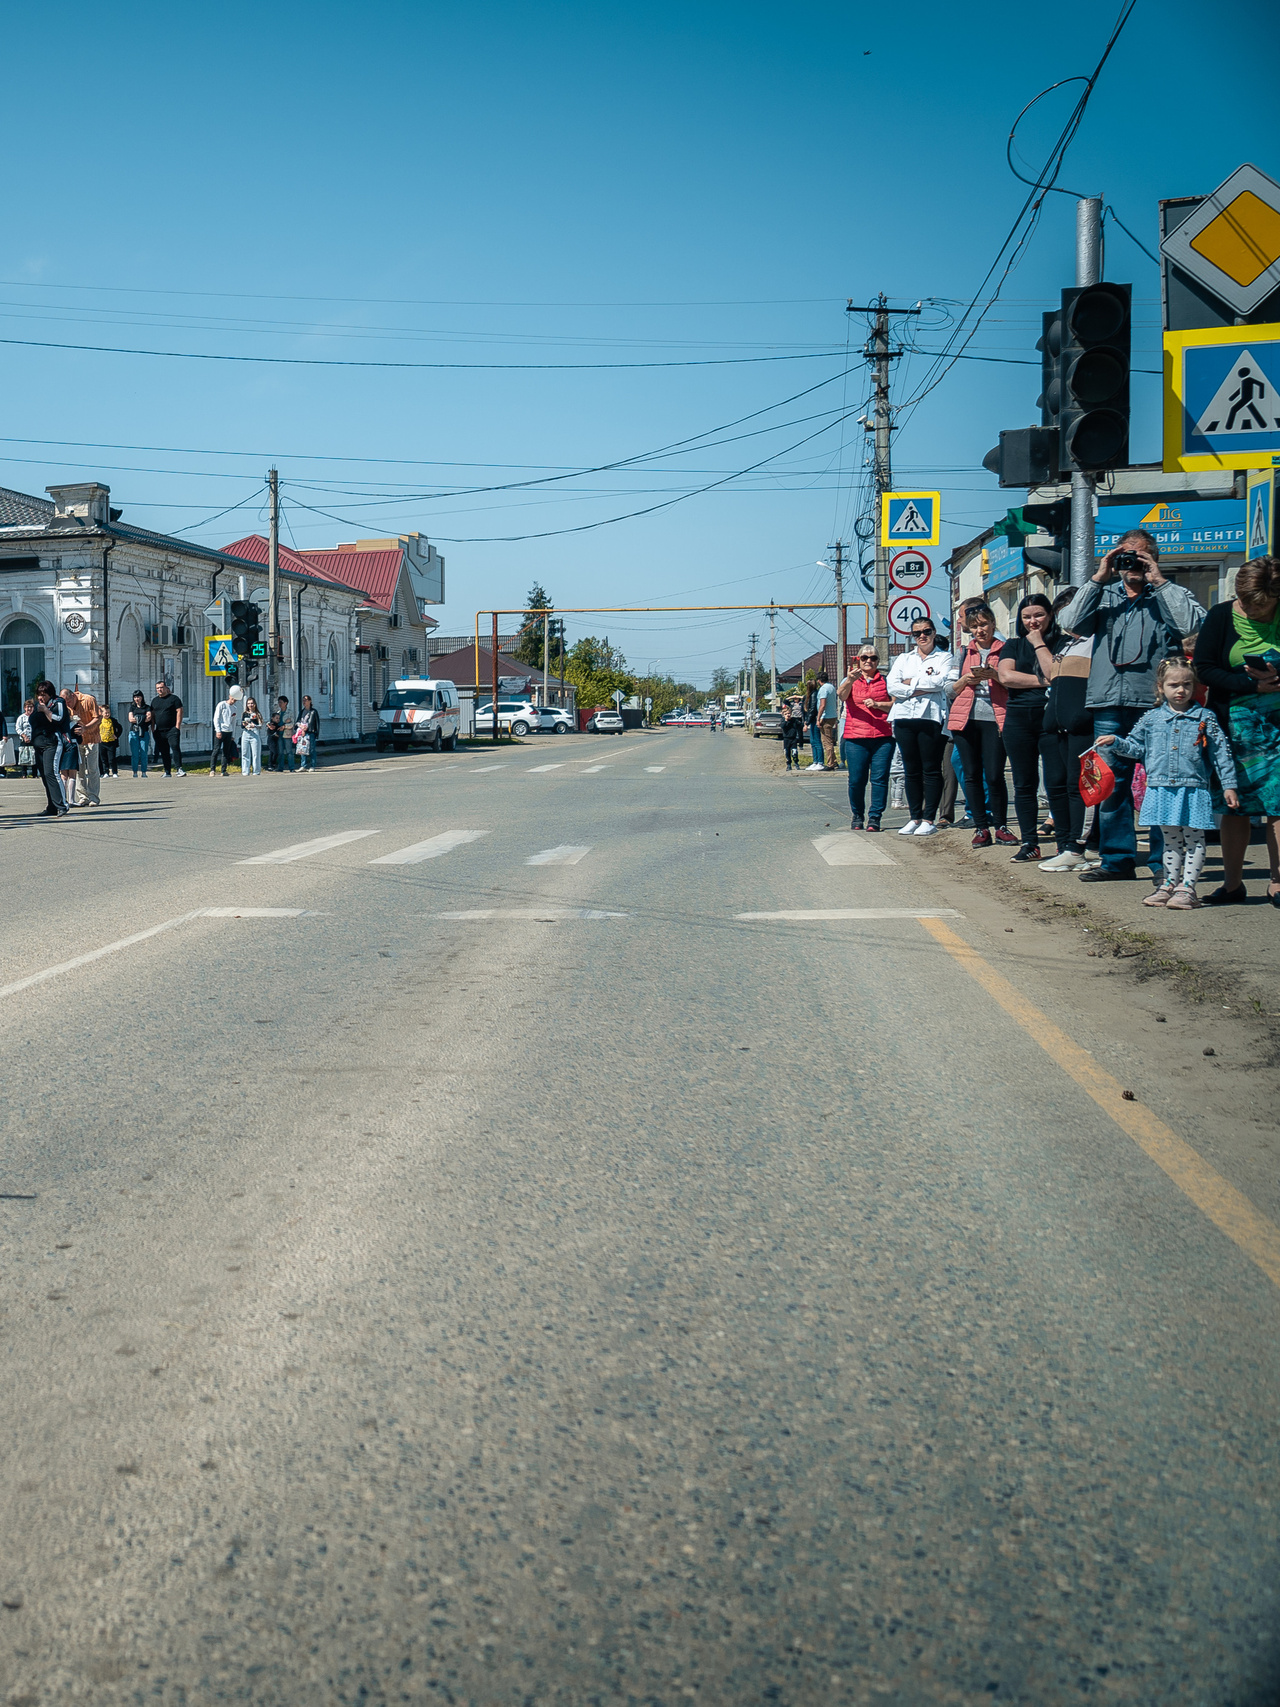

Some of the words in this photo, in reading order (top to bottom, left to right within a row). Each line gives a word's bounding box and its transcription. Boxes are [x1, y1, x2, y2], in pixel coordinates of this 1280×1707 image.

[1161, 508, 1181, 520] JIG
[1193, 530, 1245, 543] ЦЕНТР
[1191, 544, 1229, 552] ТЕХНИКИ
[896, 606, 922, 622] 40
[70, 619, 80, 627] 63
[252, 643, 265, 655] 25
